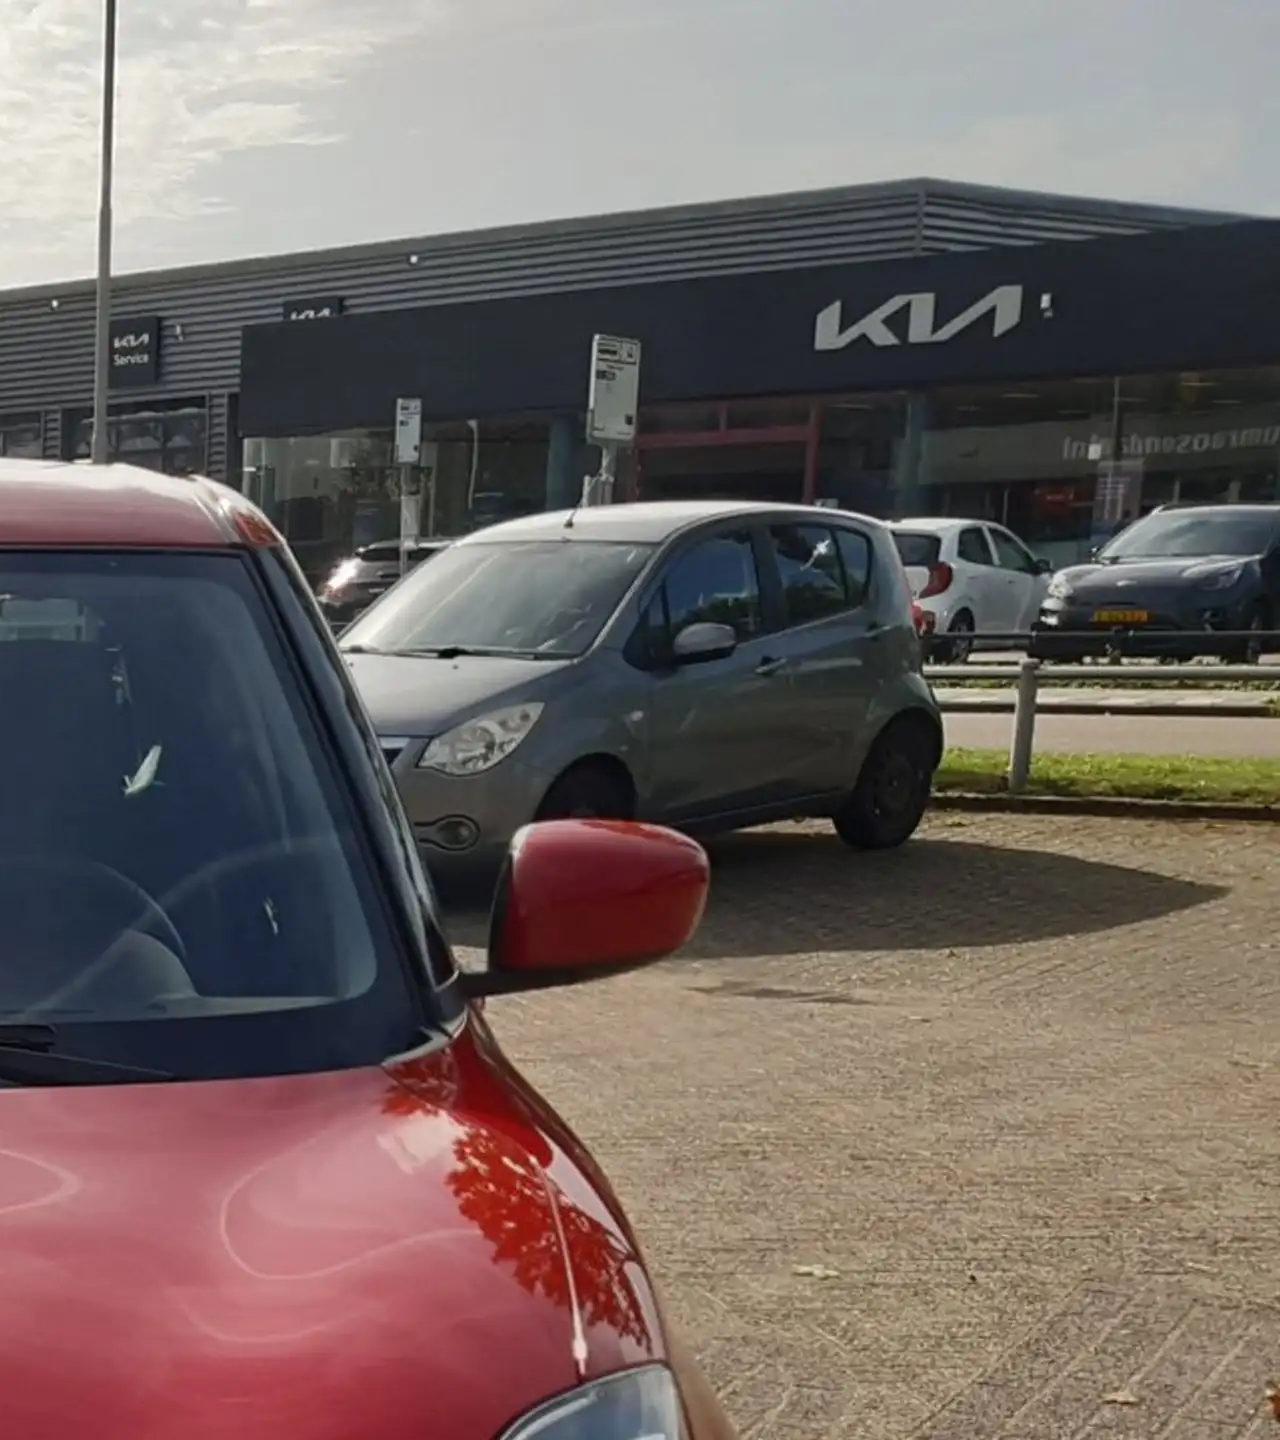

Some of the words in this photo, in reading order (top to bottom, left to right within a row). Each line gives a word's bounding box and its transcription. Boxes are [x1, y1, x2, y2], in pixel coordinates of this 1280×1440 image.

[814, 284, 1023, 351] KIA
[113, 333, 150, 349] KIA
[113, 353, 149, 366] Service
